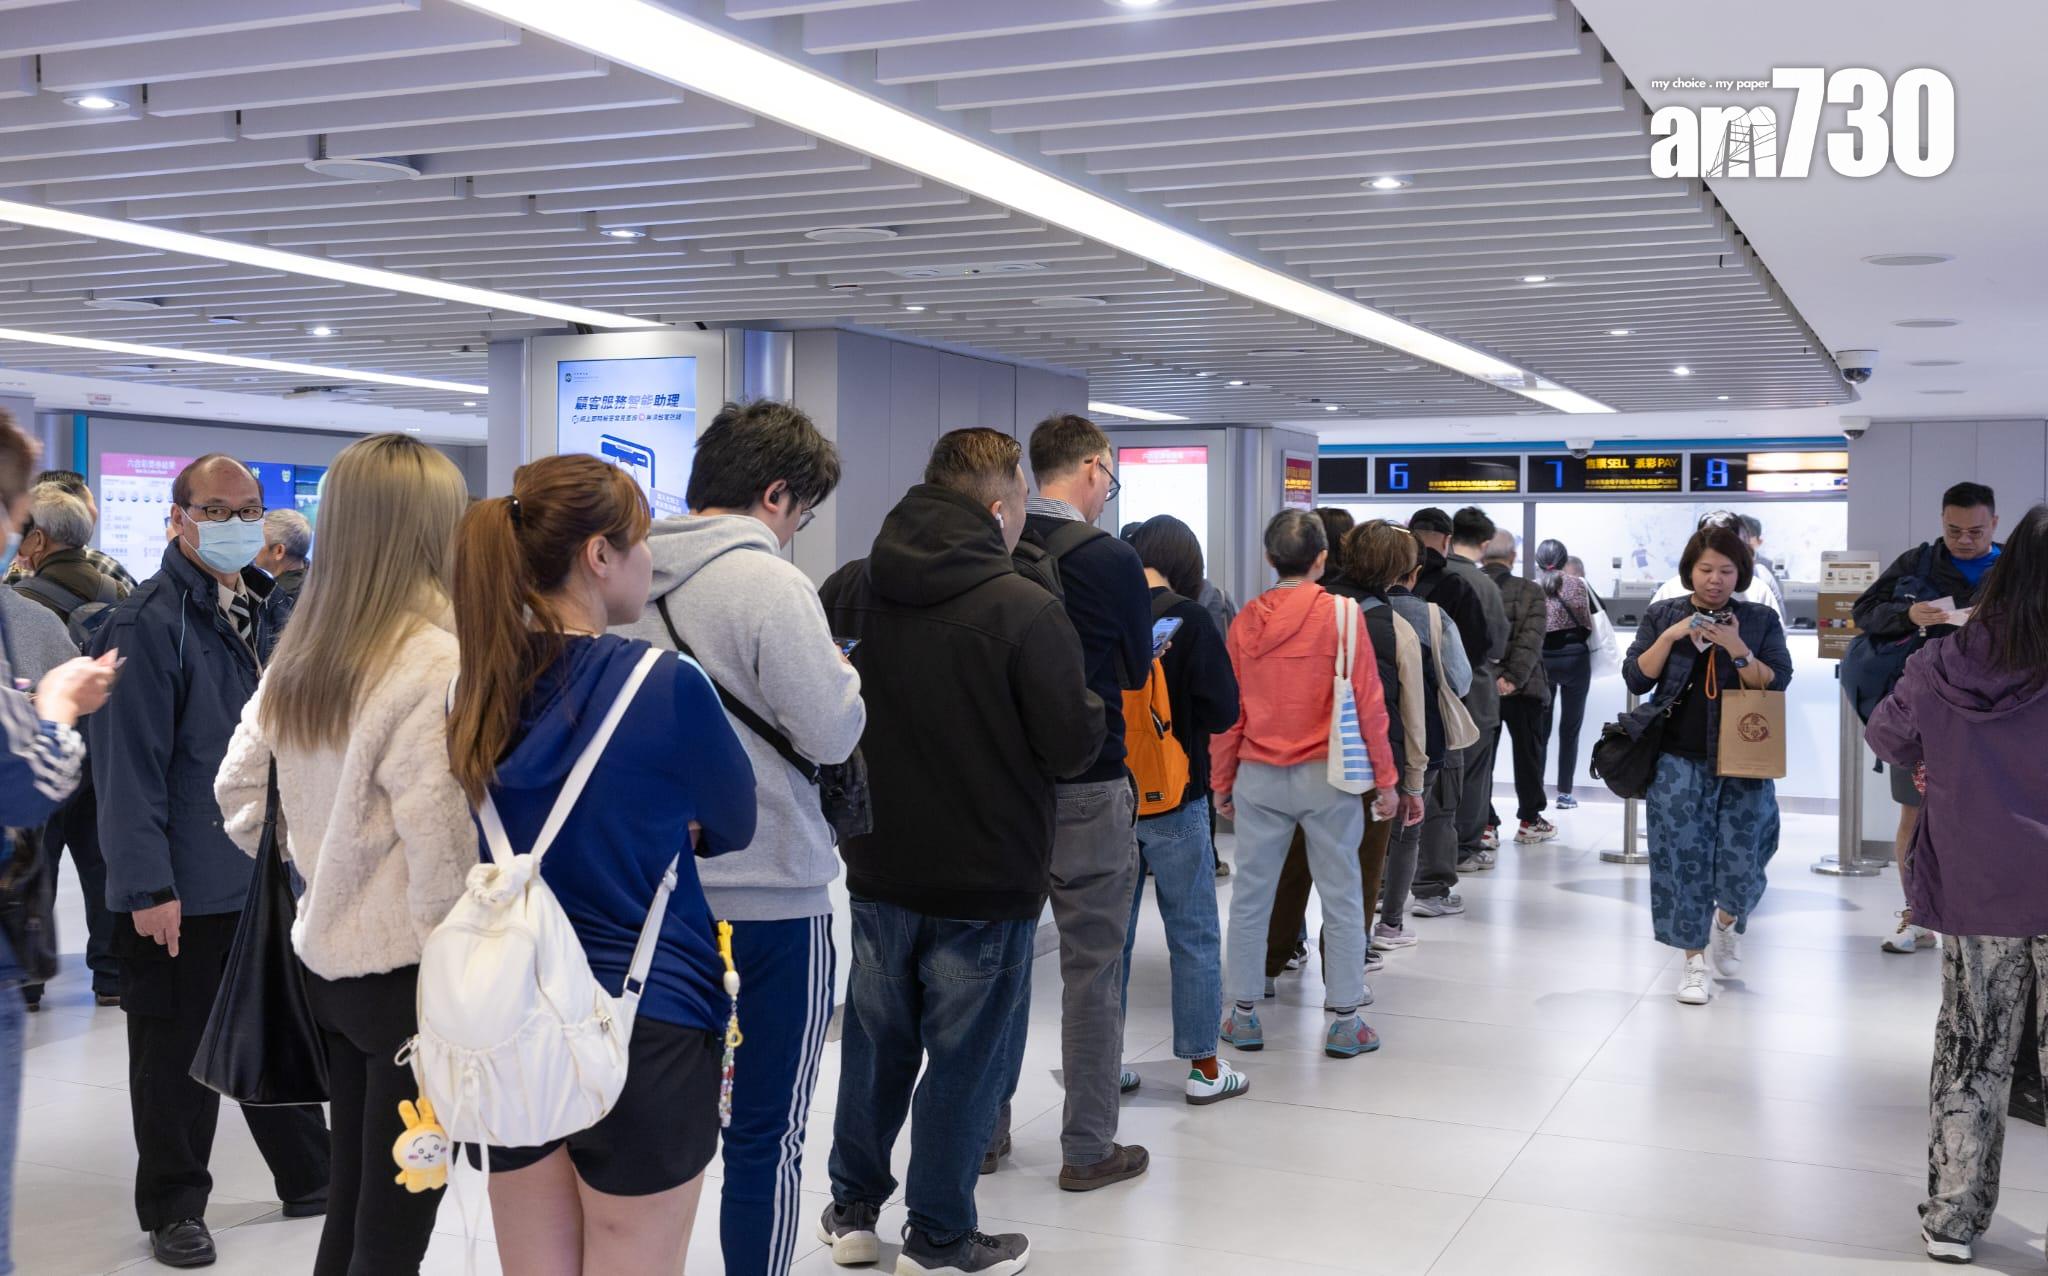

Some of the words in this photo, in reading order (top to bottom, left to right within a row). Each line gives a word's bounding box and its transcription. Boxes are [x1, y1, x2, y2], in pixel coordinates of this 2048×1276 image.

[575, 393, 680, 410] 顧客服務智能助理
[1389, 463, 1409, 489] 6
[1706, 458, 1728, 487] 8
